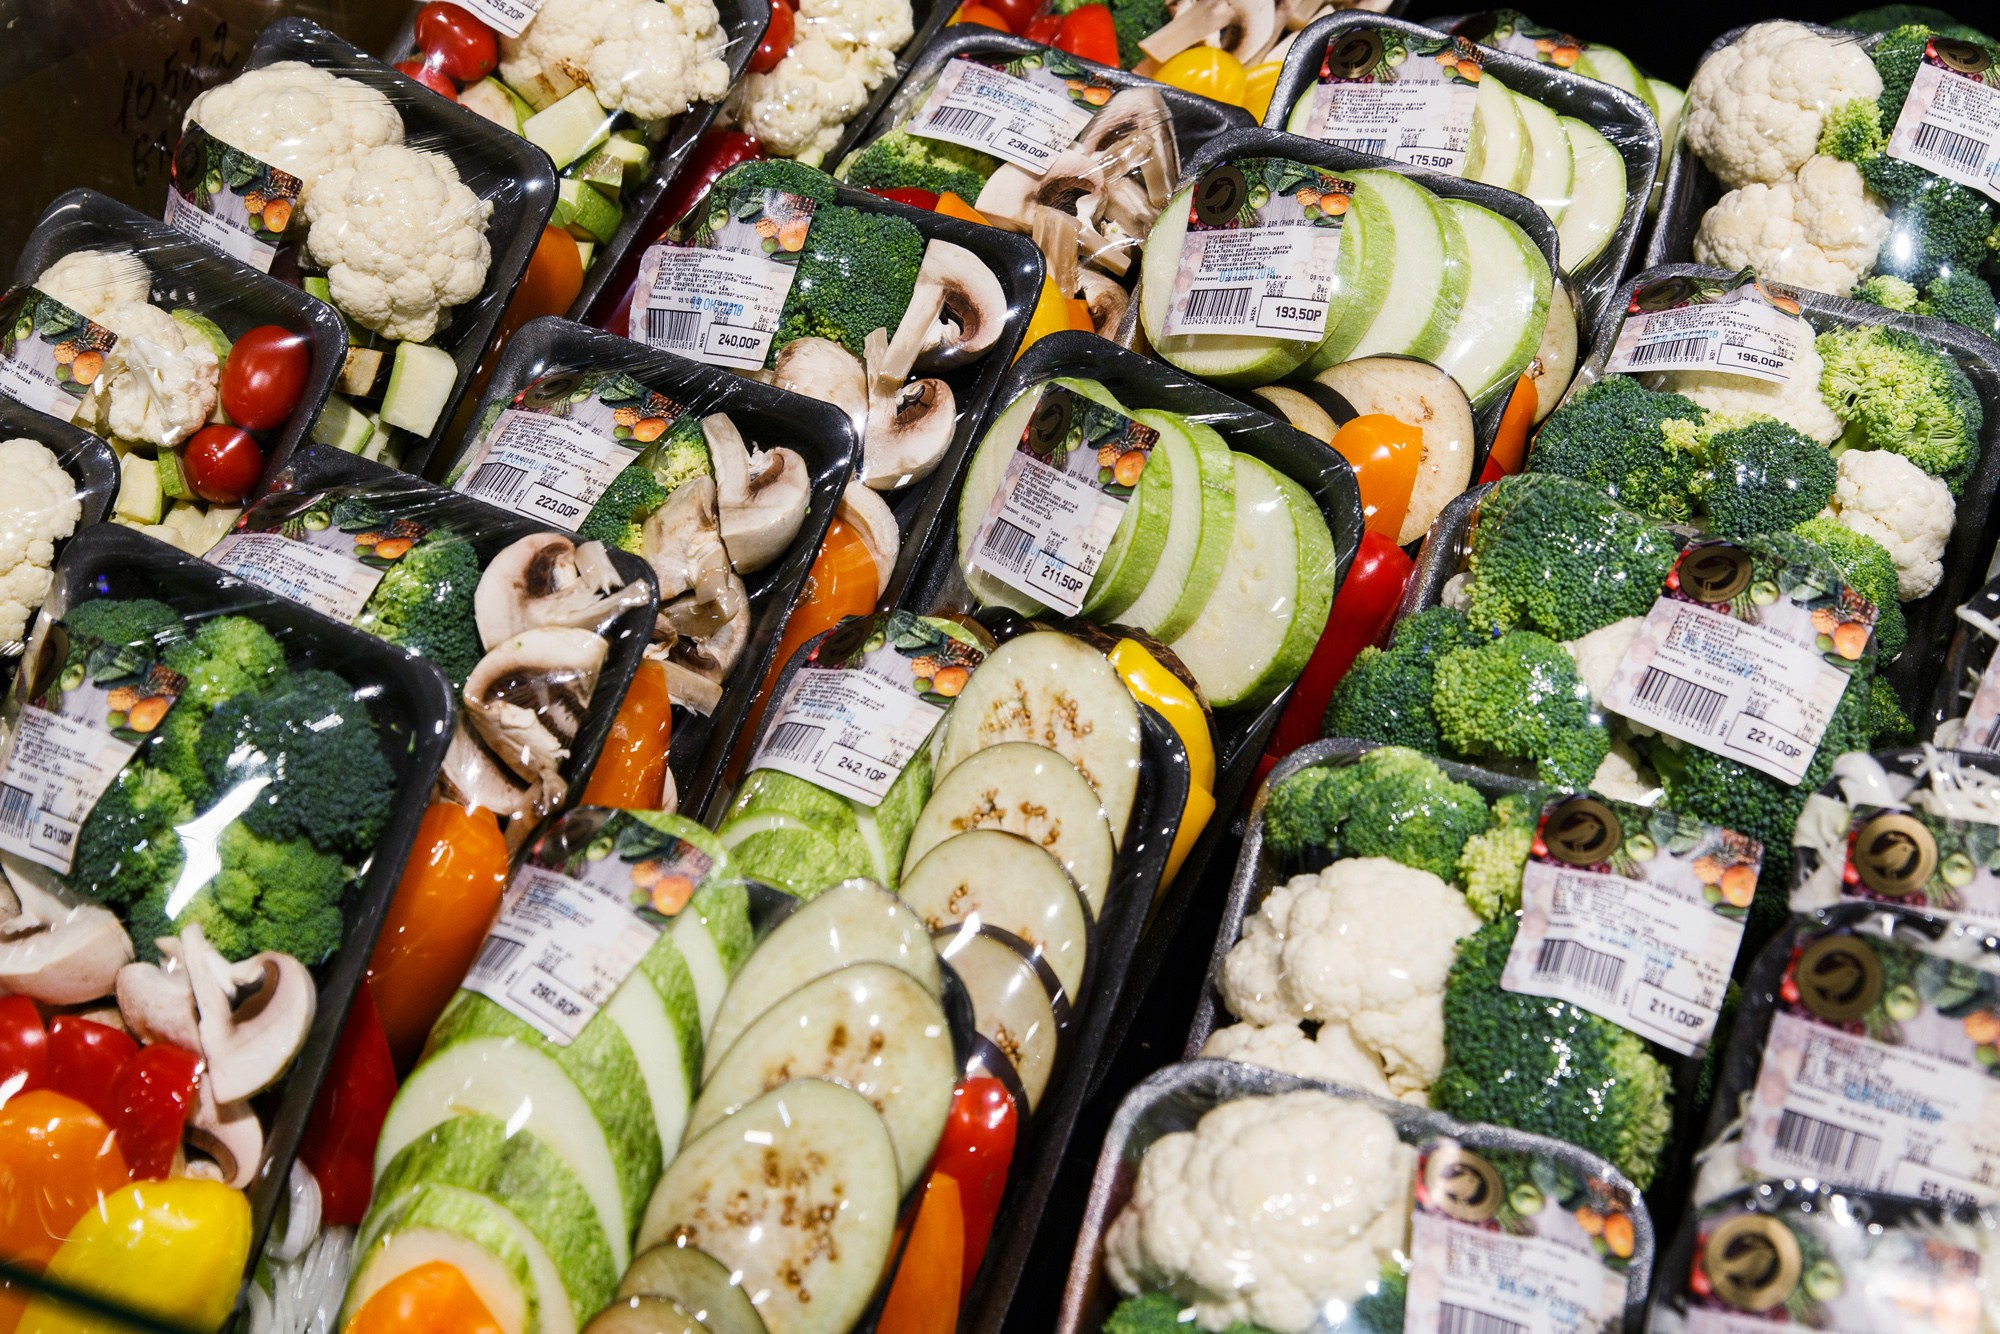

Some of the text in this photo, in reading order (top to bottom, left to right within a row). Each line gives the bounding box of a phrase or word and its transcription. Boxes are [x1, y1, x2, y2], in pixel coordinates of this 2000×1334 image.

[1736, 351, 1784, 369] 196,00Р
[535, 495, 579, 518] 223,00Р
[1041, 565, 1083, 592] 211,50Р
